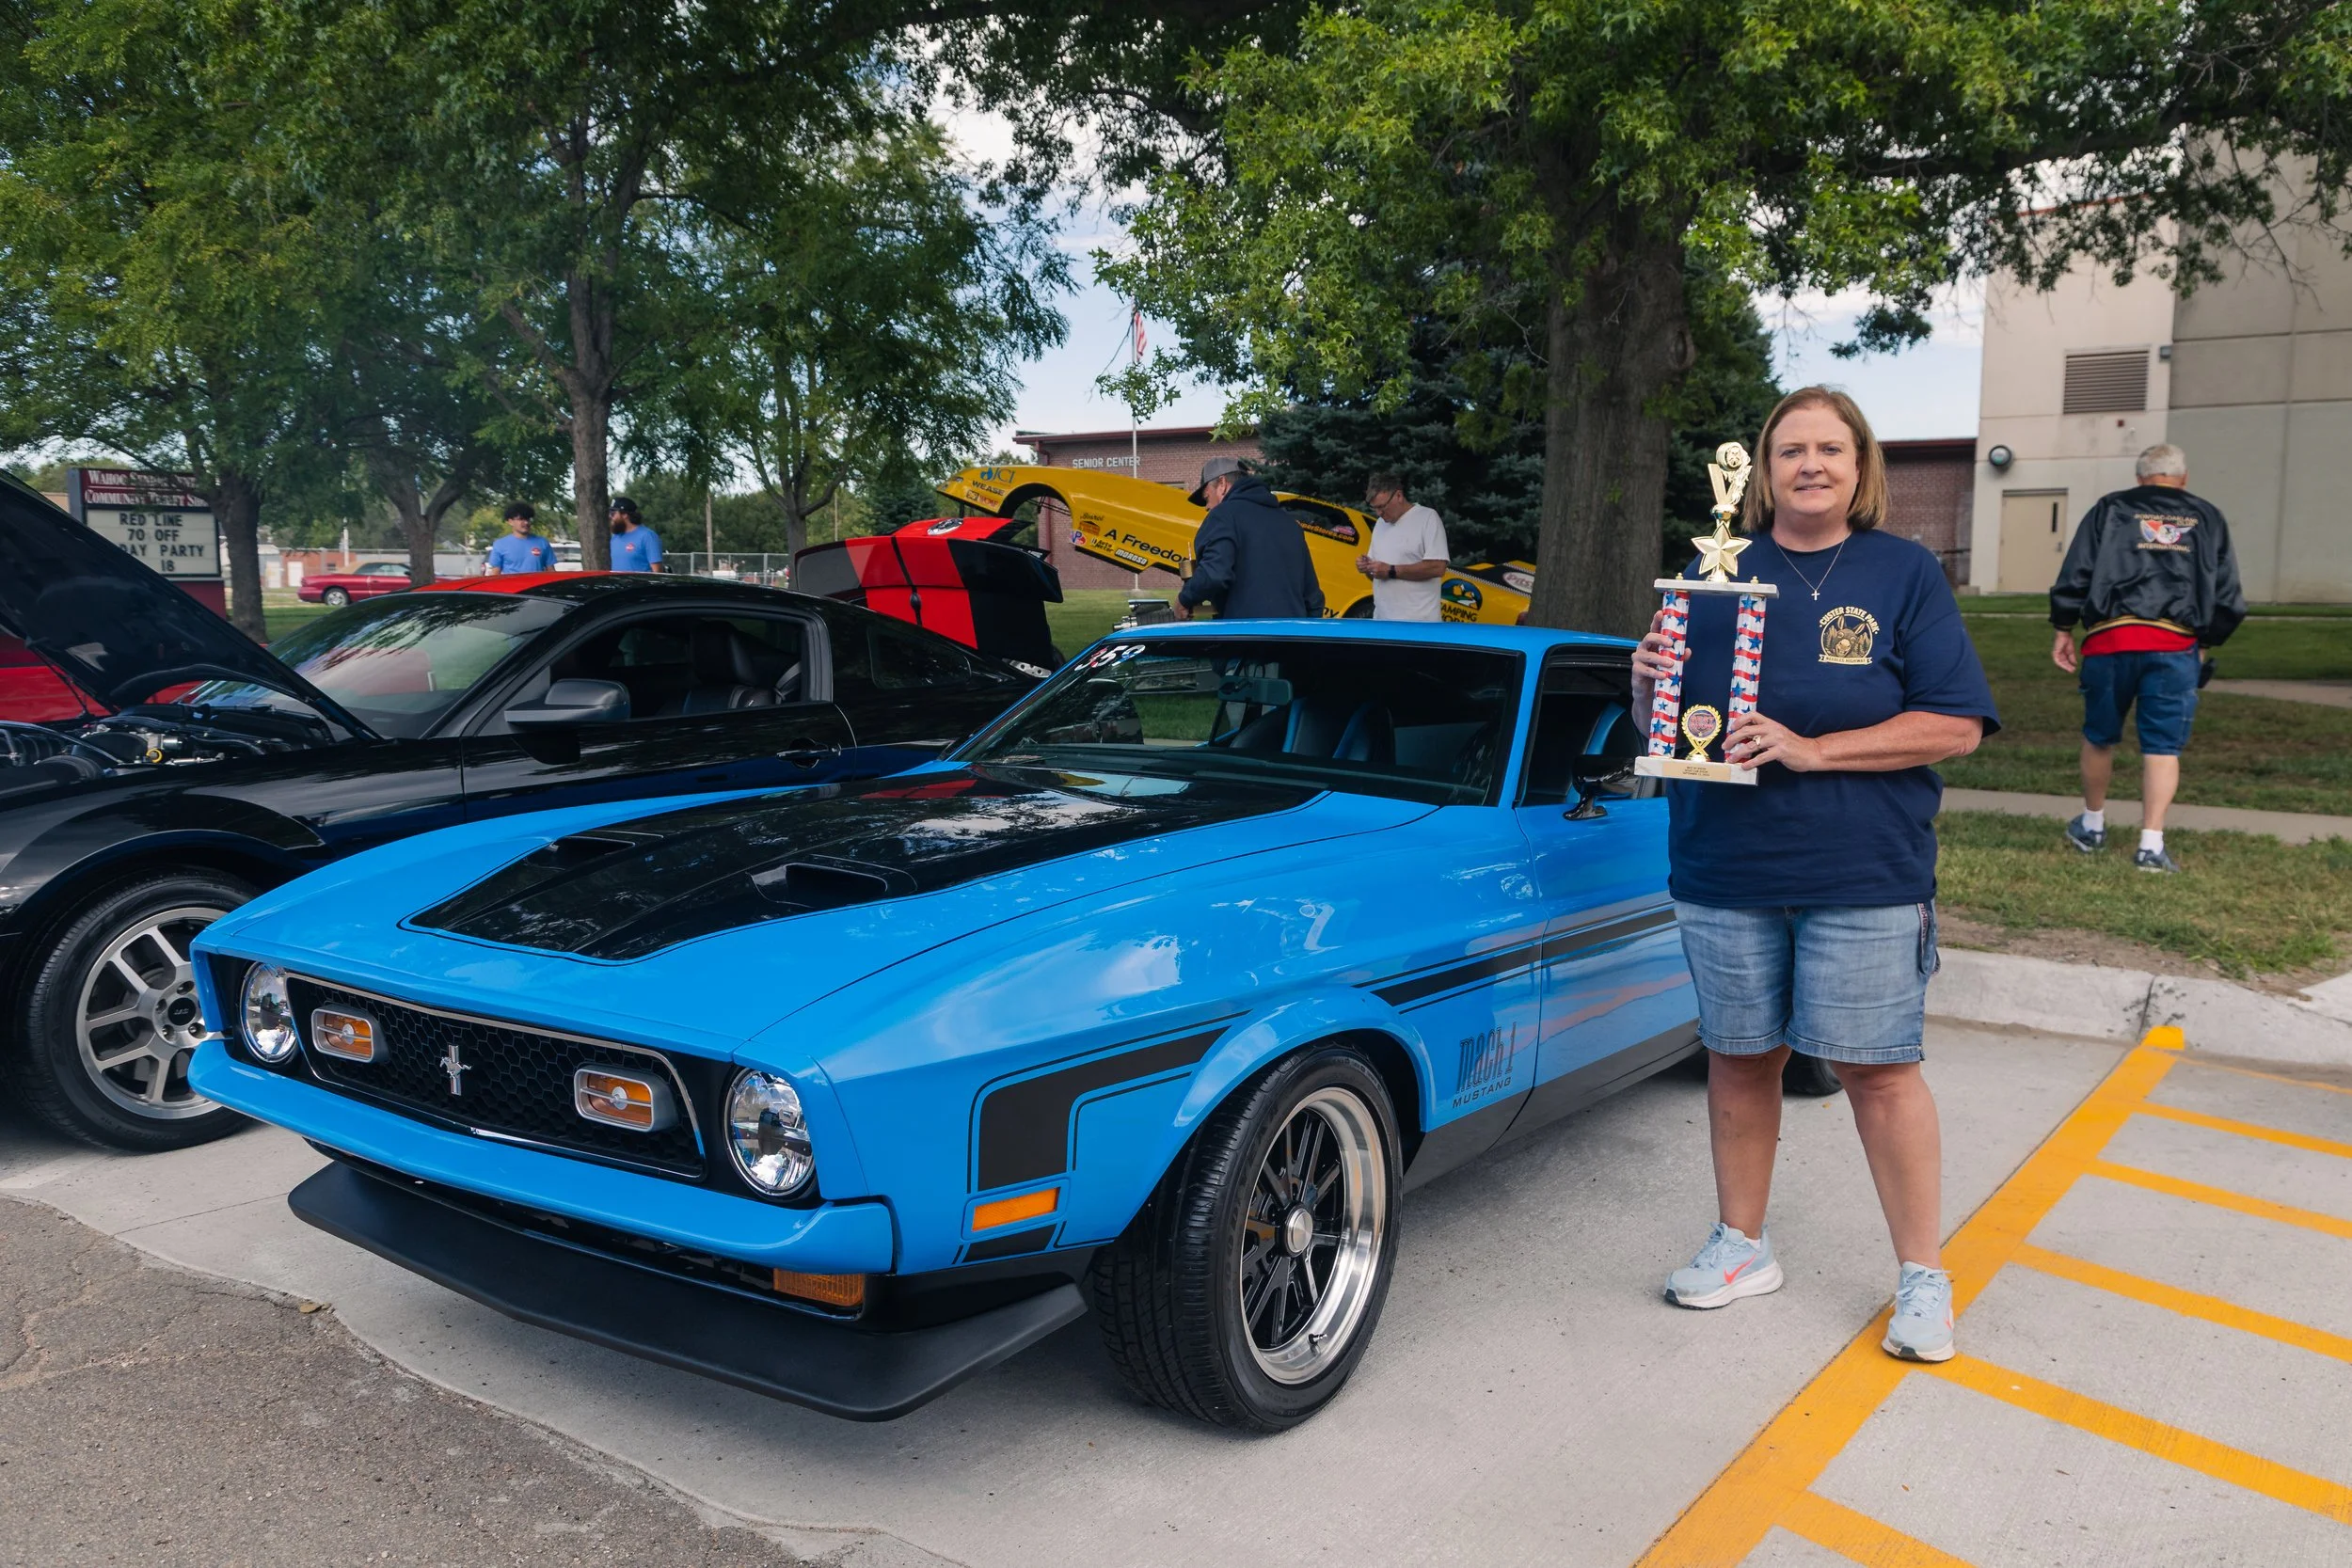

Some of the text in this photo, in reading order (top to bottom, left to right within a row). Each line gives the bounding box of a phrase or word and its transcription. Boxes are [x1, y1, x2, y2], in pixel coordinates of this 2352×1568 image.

[1073, 456, 1140, 468] SENIOR CENTER
[119, 513, 183, 527] RED LINE
[127, 529, 181, 542] 70 OFF
[1104, 529, 1117, 541] A
[161, 545, 204, 558] PARTY
[1440, 602, 1477, 622] AMPING
[1820, 606, 1880, 633] CUSTER STATE PARK
[1453, 1077, 1512, 1108] MUSTANG
